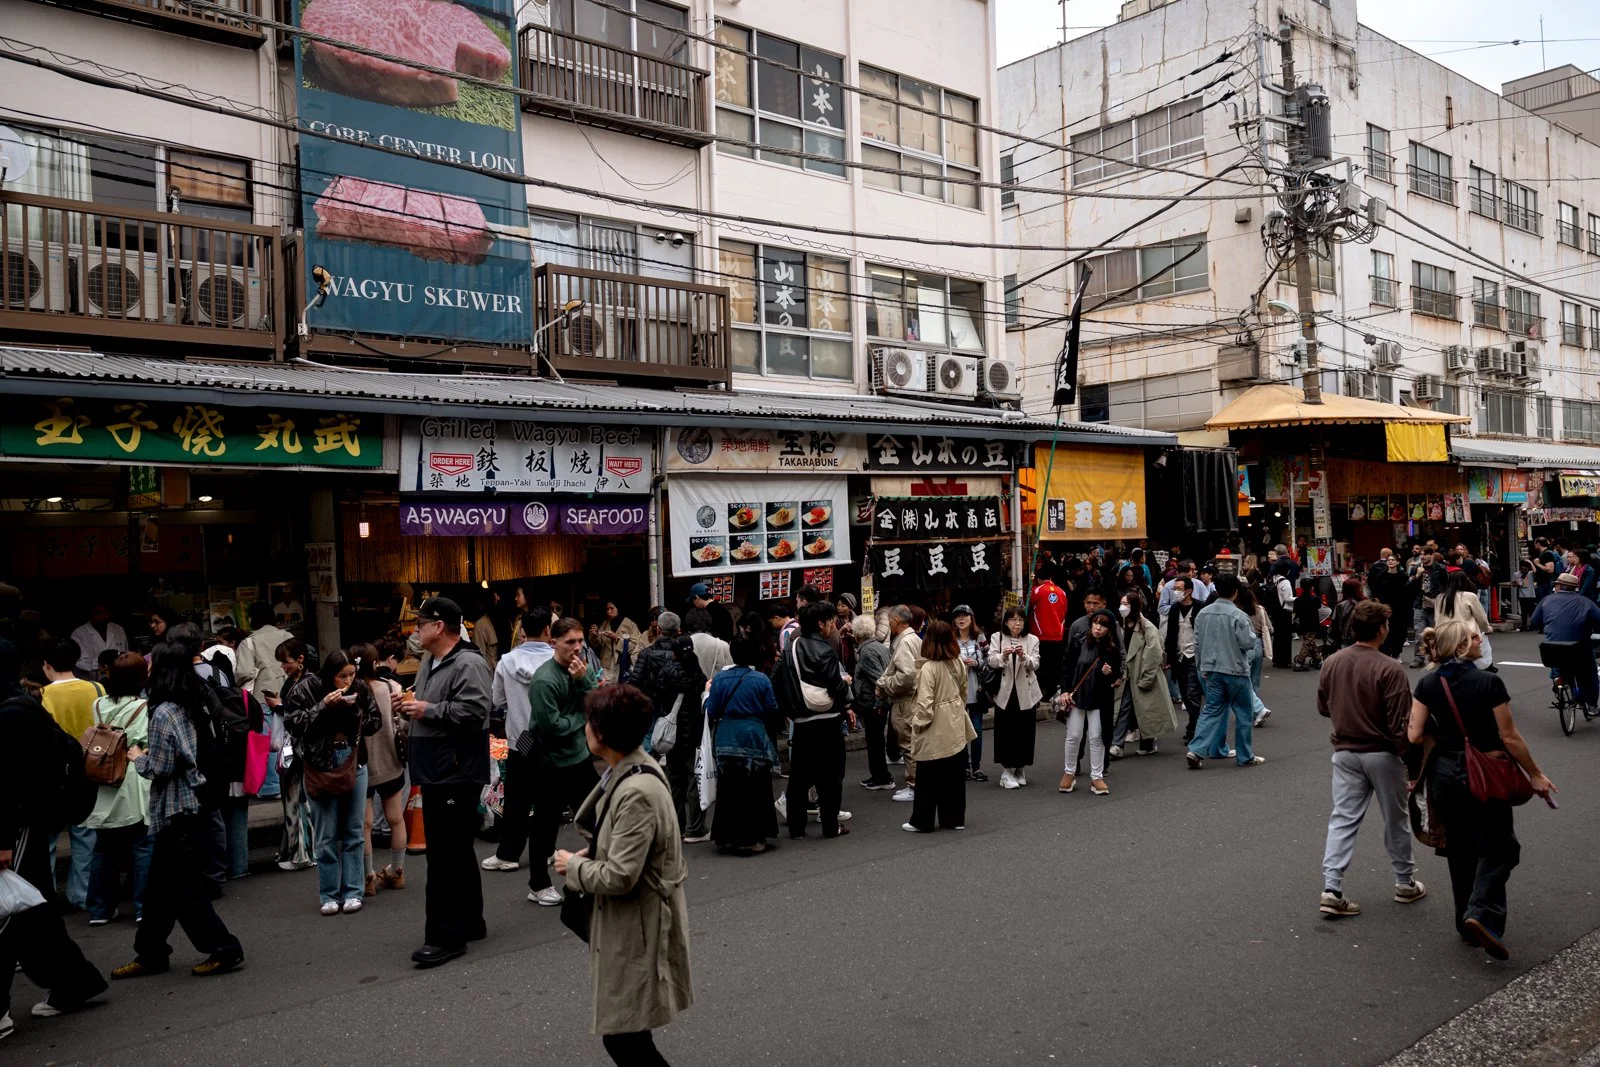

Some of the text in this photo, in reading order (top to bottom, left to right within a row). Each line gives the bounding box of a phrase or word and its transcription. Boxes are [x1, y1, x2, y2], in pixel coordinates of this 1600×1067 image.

[378, 134, 461, 165] CENTER
[469, 150, 517, 174] LOIN
[327, 275, 523, 314] WAGYU SKEWER
[254, 413, 362, 458] 丸武
[421, 417, 641, 447] Grilled Wagyu Beef
[721, 437, 770, 453] 築地海鮮
[432, 457, 471, 467] ORDER HERE
[476, 446, 592, 475] 鉄板焼
[608, 460, 640, 469] WAIT HERE
[778, 457, 839, 467] TAKARABUNE
[430, 472, 471, 489] 築地
[480, 478, 587, 488] Teppan-Yaki Tsukiji Ihachi
[596, 477, 632, 490] 伊八
[432, 506, 507, 525] WAGYU
[566, 506, 645, 525] SEAFOOD
[881, 542, 990, 578] 豆 豆 豆
[862, 596, 872, 604] eat
